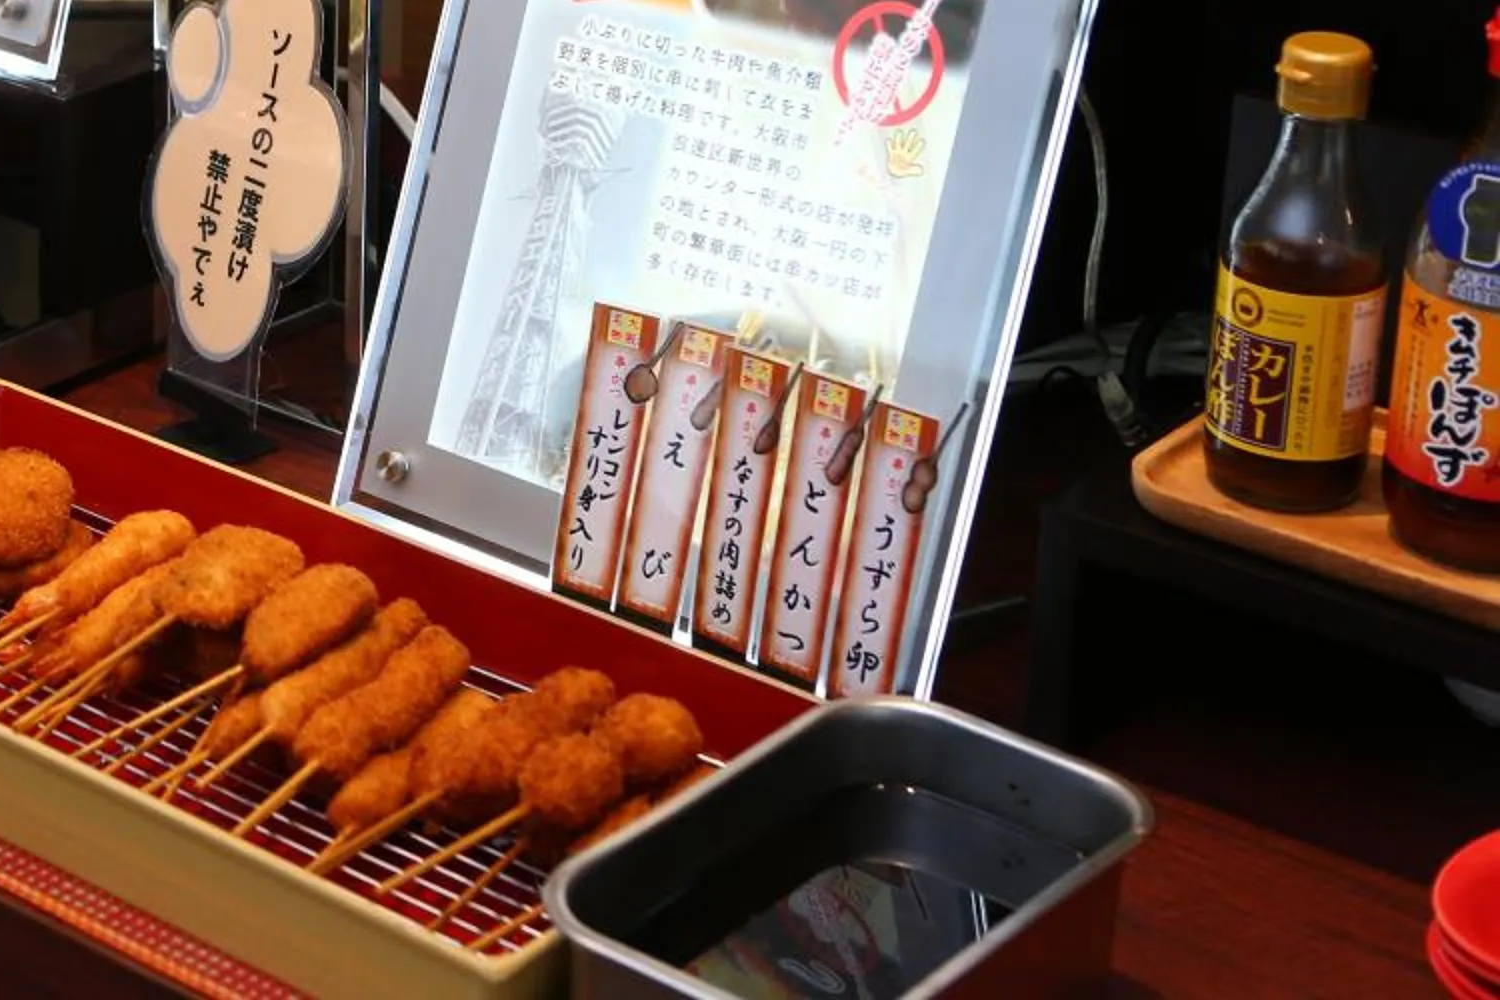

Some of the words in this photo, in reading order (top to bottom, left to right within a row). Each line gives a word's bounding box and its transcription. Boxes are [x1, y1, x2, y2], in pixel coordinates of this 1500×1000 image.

[190, 149, 231, 307] 禁止やでぇ
[227, 29, 292, 283] ソースの二度漬け
[600, 409, 629, 500] レンコン
[1249, 343, 1287, 440] カレー
[570, 427, 608, 571] すり身入り
[641, 432, 686, 579] えび
[712, 456, 754, 624] なすの肉詰め
[778, 481, 827, 650] とんかつ
[846, 515, 896, 683] うずら卵
